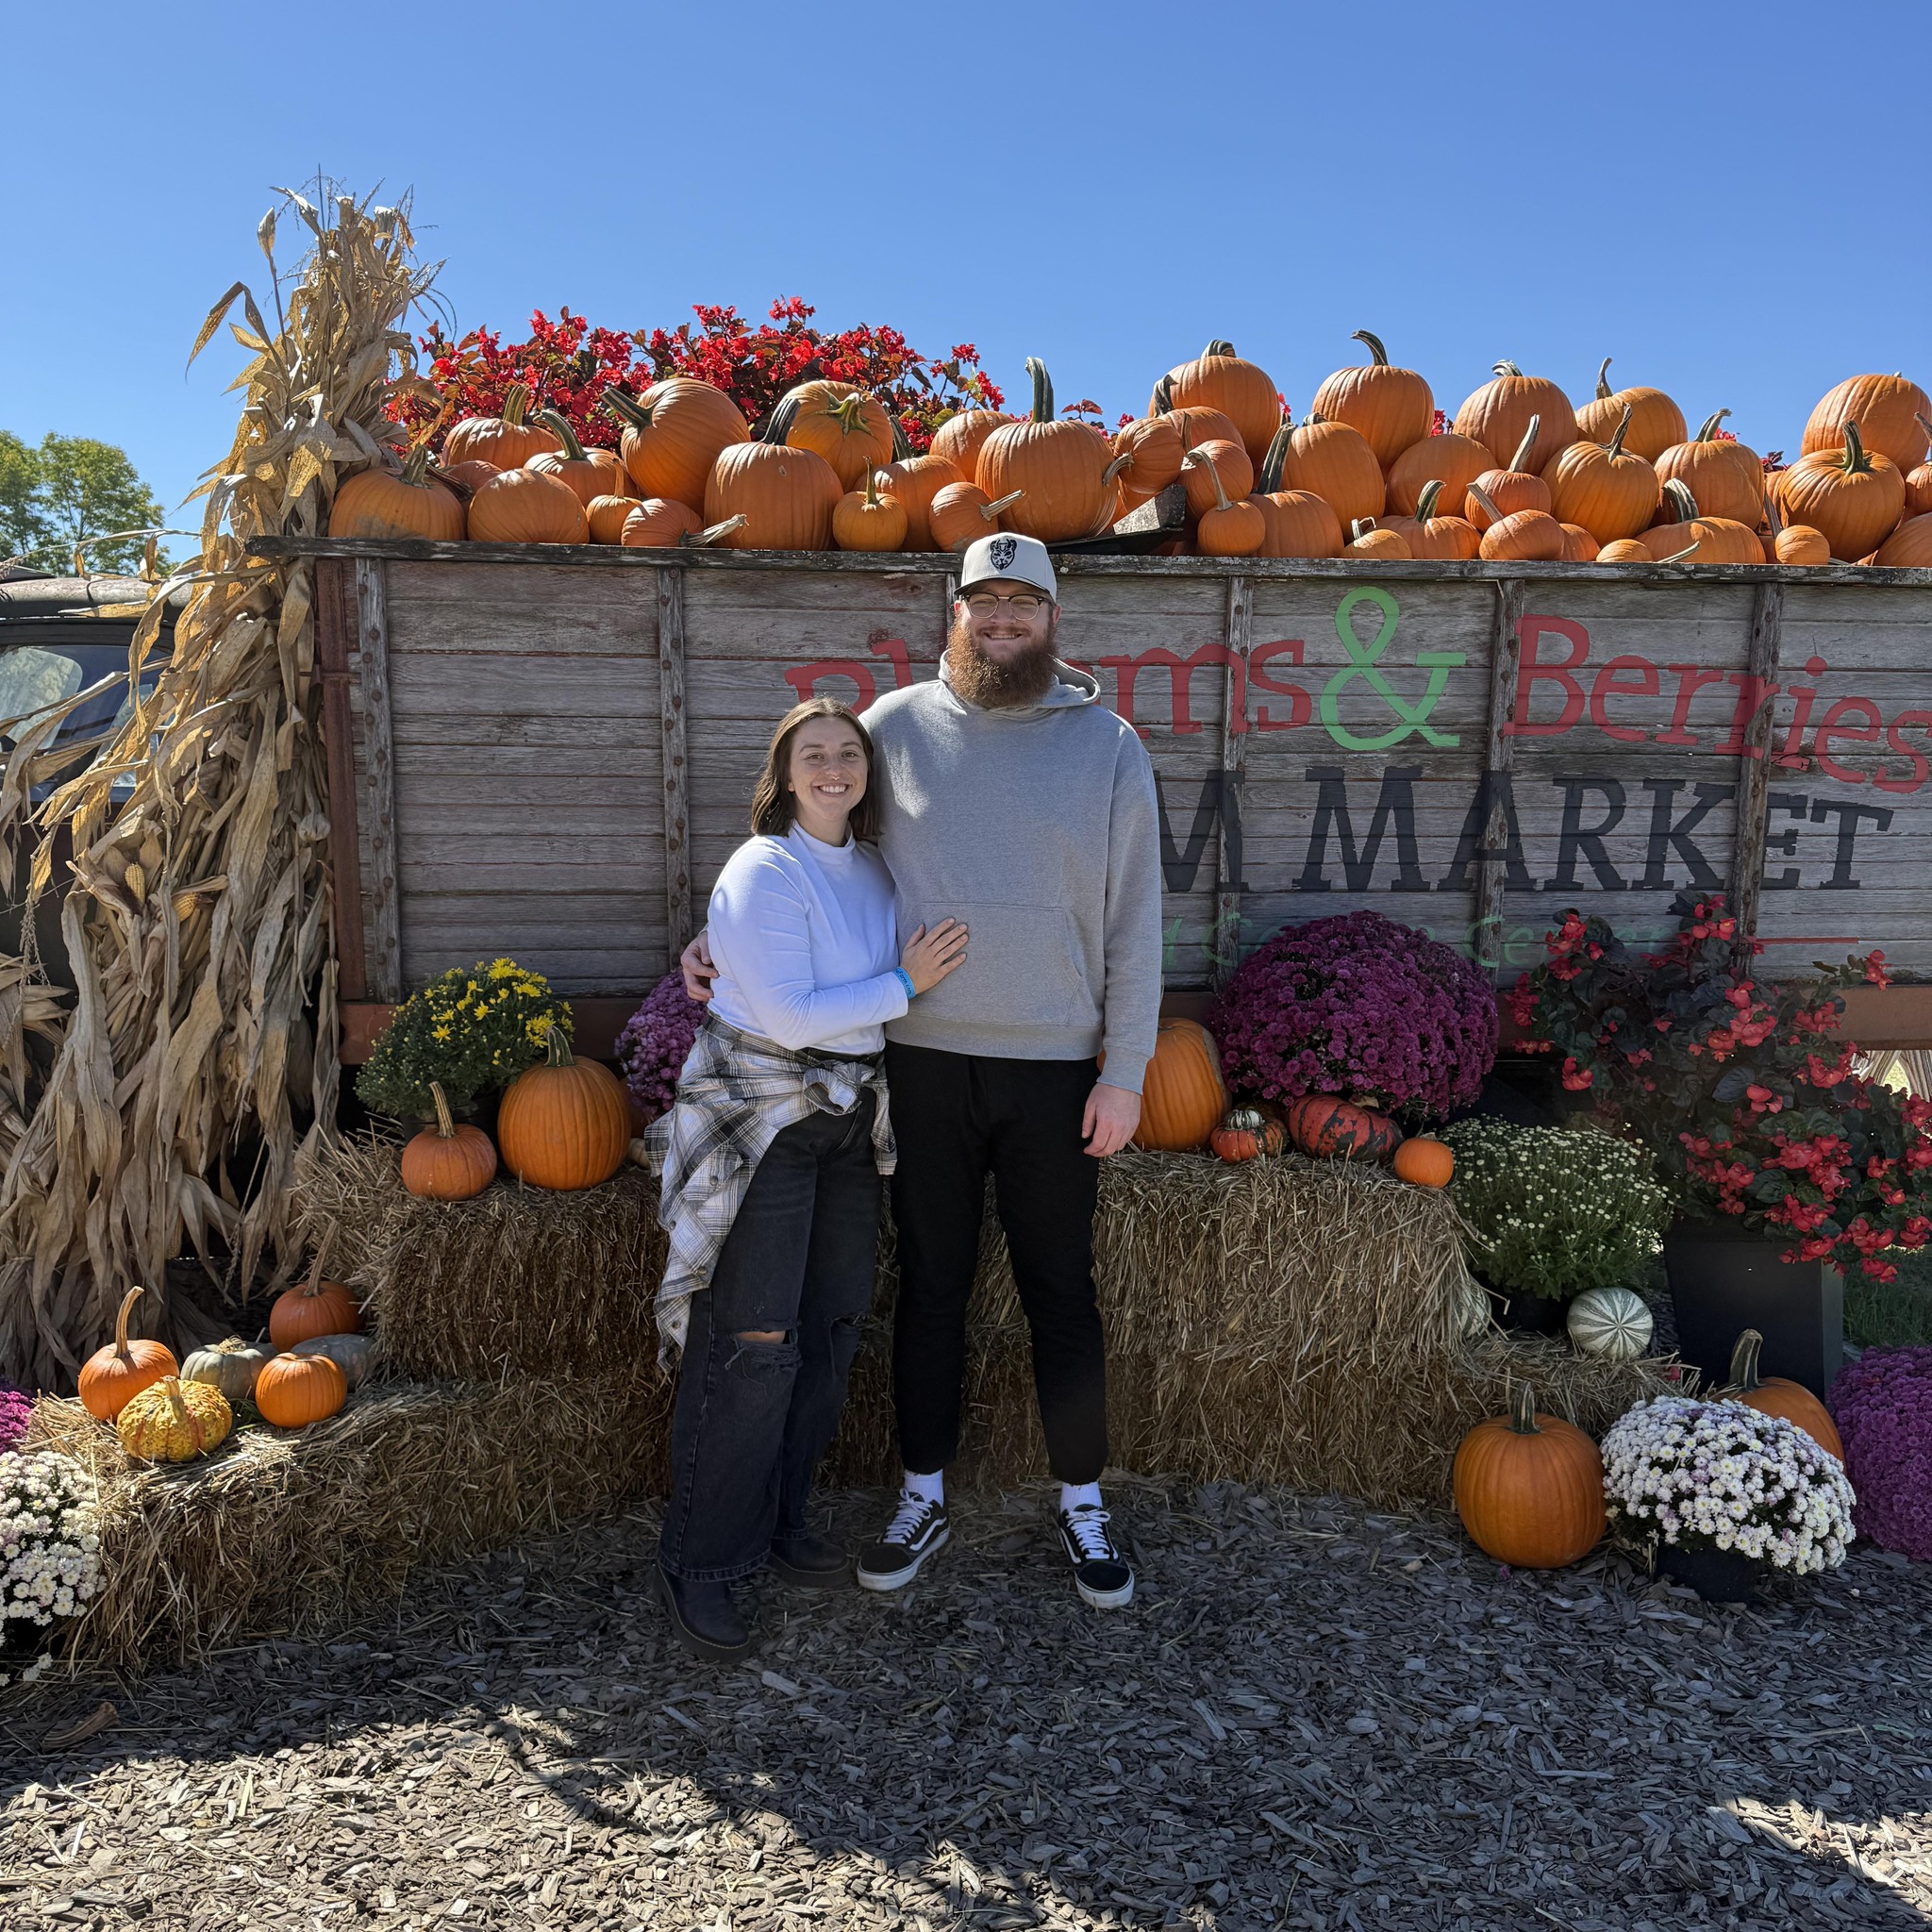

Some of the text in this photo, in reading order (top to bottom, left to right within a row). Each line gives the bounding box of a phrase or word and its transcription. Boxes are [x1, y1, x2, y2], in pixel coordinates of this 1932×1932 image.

[1320, 586, 1467, 751] &
[1503, 613, 1932, 794] Berries
[1291, 765, 1894, 892] MARKET
